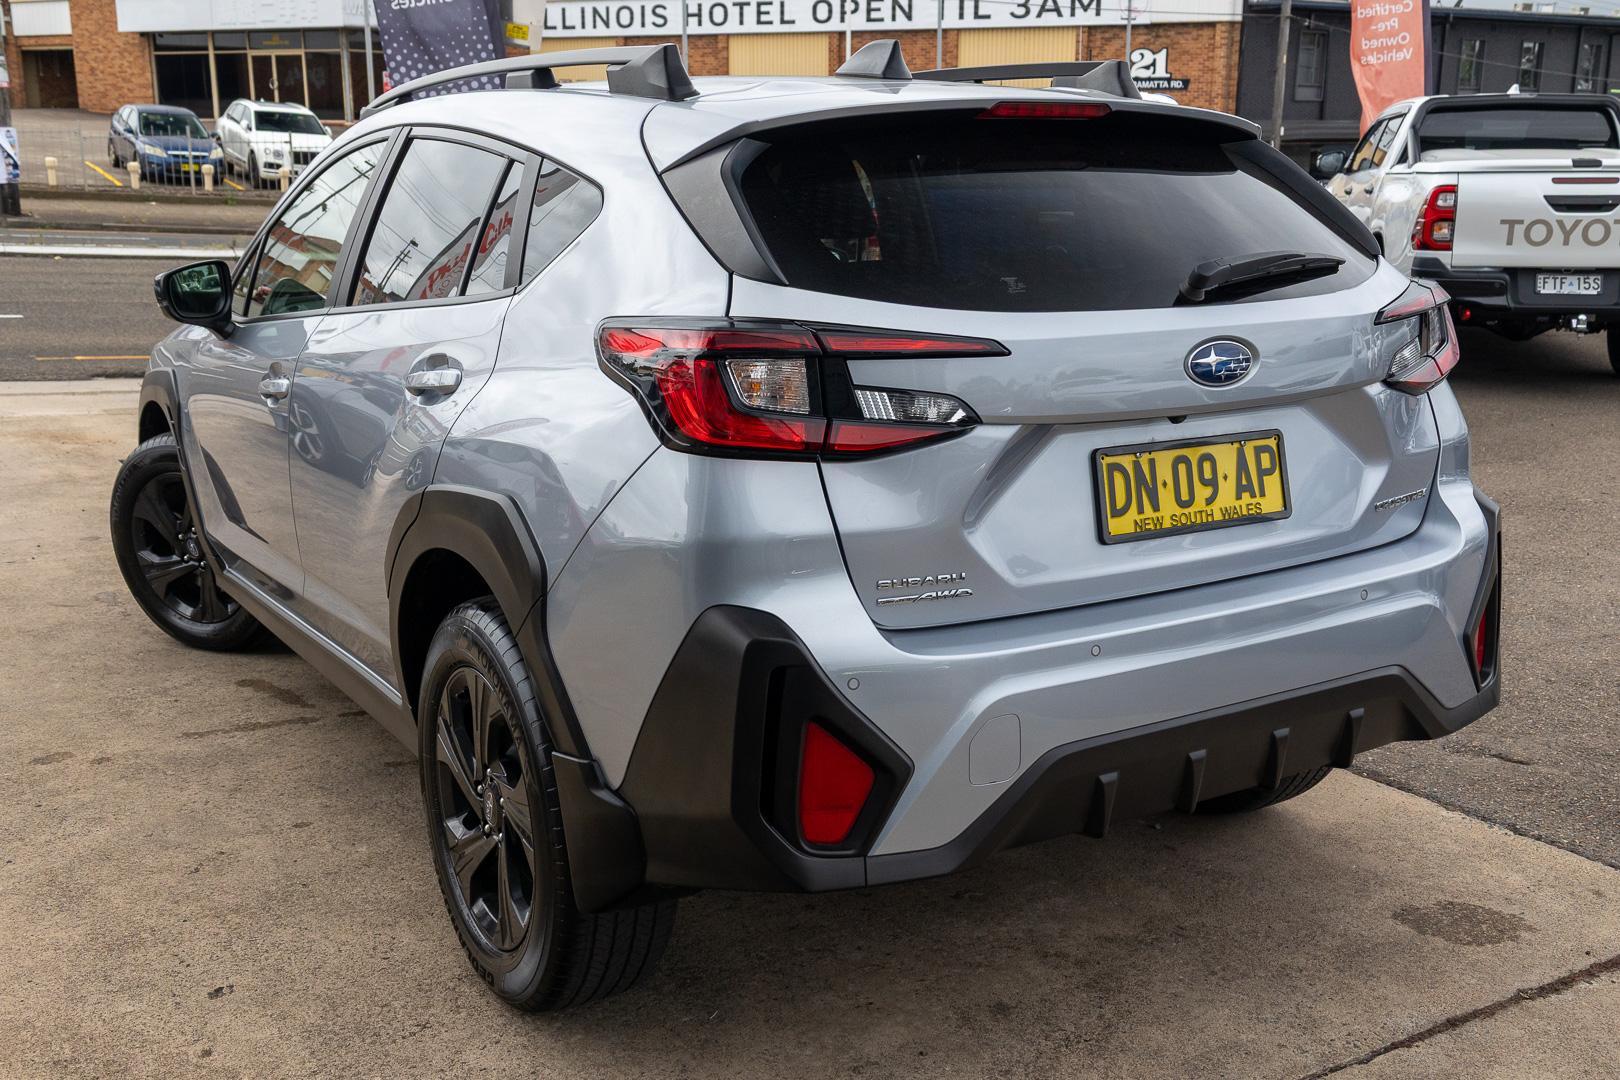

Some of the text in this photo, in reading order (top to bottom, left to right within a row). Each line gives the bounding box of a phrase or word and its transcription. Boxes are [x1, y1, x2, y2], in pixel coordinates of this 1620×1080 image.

[686, 1, 795, 27] HOTEL
[812, 0, 912, 24] OPEN
[1009, 0, 1101, 19] 3AM
[1131, 48, 1171, 78] 21
[1133, 502, 1263, 533] NEW SOUTH WALES
[875, 572, 967, 590] SUBARU
